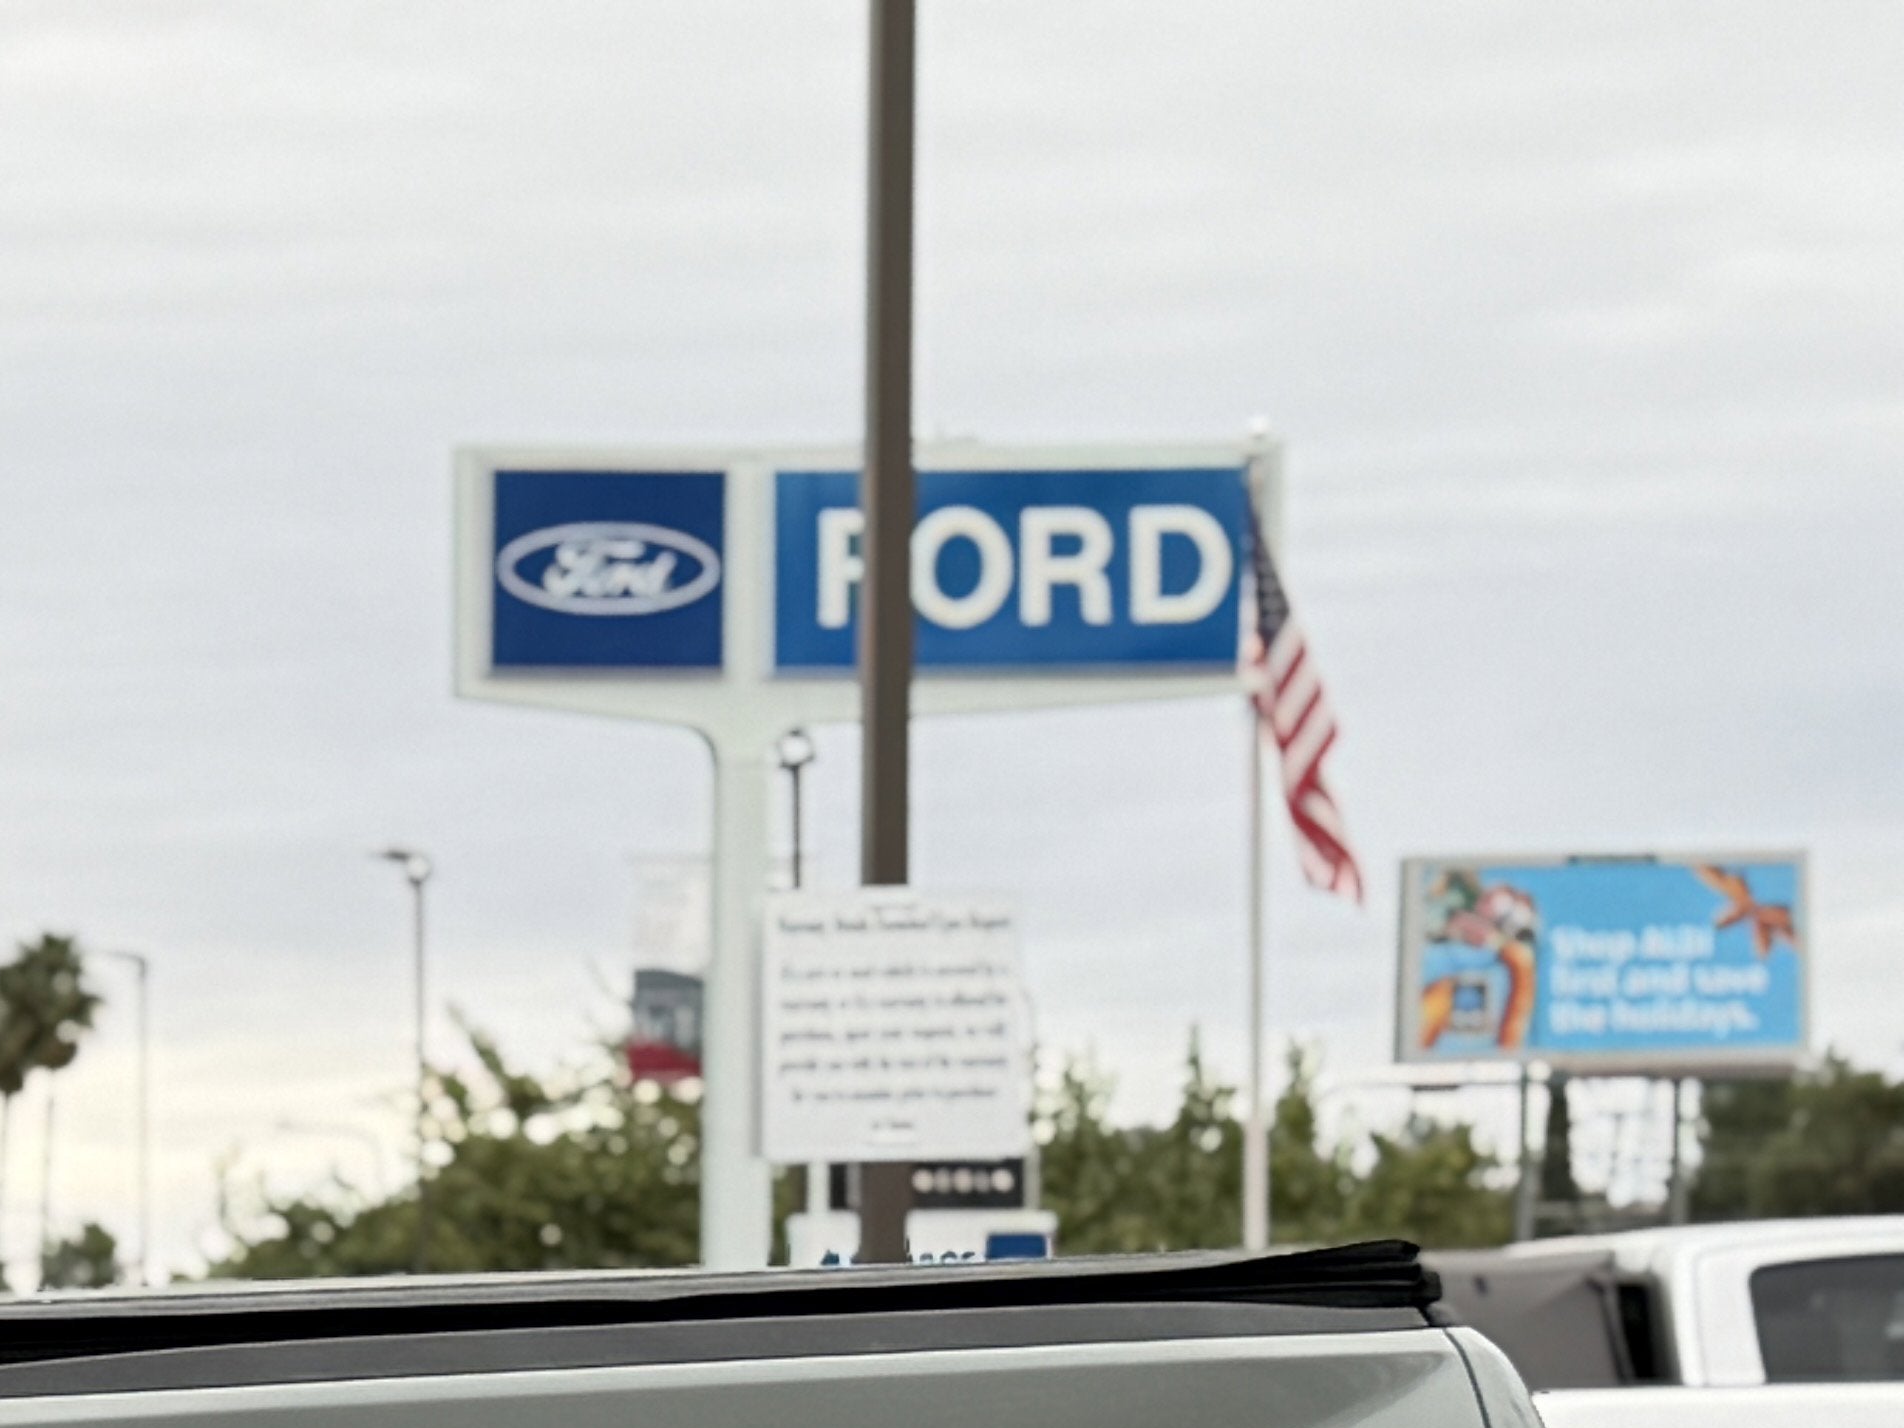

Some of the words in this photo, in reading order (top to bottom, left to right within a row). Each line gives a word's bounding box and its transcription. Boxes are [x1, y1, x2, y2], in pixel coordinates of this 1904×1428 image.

[543, 539, 676, 598] Ford
[816, 504, 1234, 631] FORD
[1623, 963, 1689, 996] and
